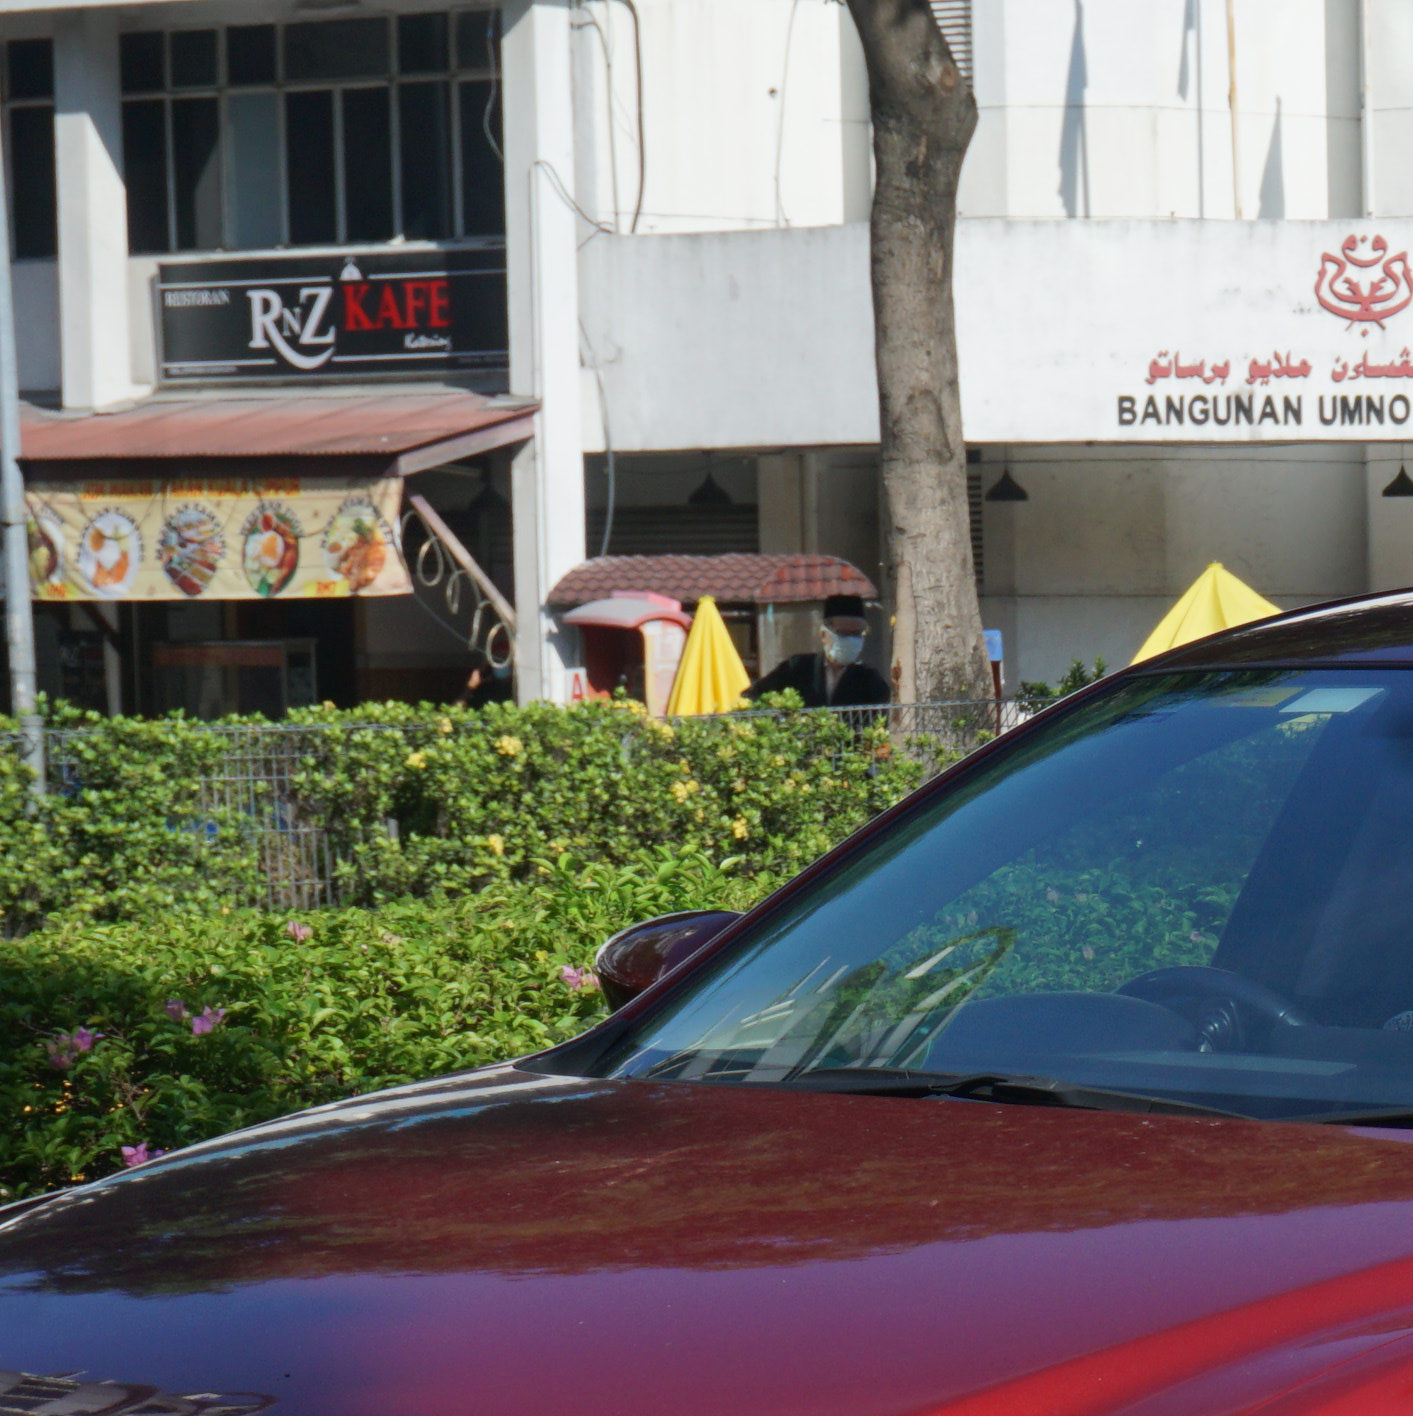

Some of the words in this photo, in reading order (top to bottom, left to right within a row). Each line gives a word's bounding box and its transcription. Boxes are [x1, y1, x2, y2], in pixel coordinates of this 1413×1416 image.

[164, 290, 230, 307] RESTORAN
[343, 280, 453, 331] KAFE
[1117, 395, 1303, 426] BANGUNAN
[1318, 394, 1411, 426] UMNO
